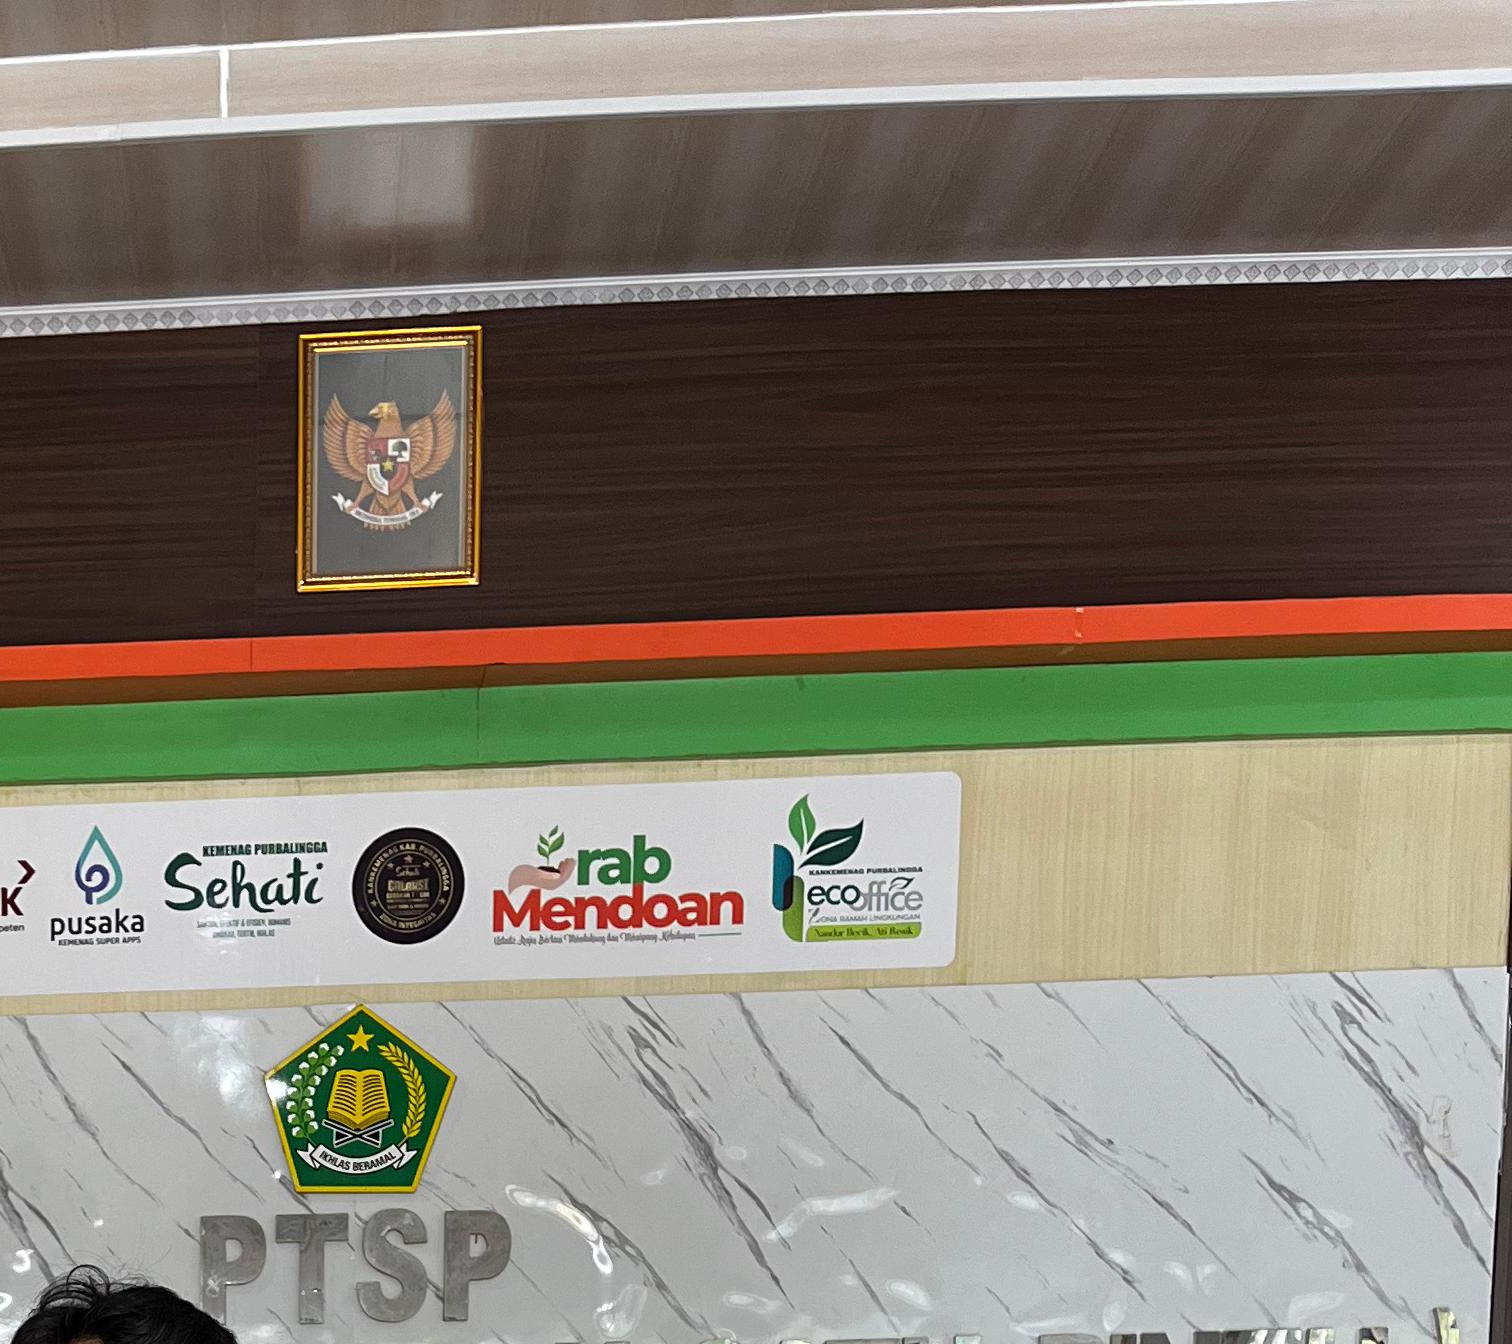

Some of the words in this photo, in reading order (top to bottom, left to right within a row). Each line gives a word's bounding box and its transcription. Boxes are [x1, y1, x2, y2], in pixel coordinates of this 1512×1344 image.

[202, 843, 252, 857] KEMENAG
[254, 841, 328, 856] PURBALINGGA
[164, 852, 324, 913] Sehati
[808, 867, 865, 876] KANKEMENAG
[866, 866, 923, 875] PURBALINGGA
[492, 884, 745, 933] Mendoan
[50, 908, 145, 941] pusaka
[58, 938, 94, 946] KEMENAG
[96, 937, 121, 945] SUPER
[122, 936, 142, 945] APPS
[318, 1150, 351, 1171] IKHLAS
[352, 1151, 397, 1171] BERAMAL
[199, 1208, 512, 1325] PTSP
